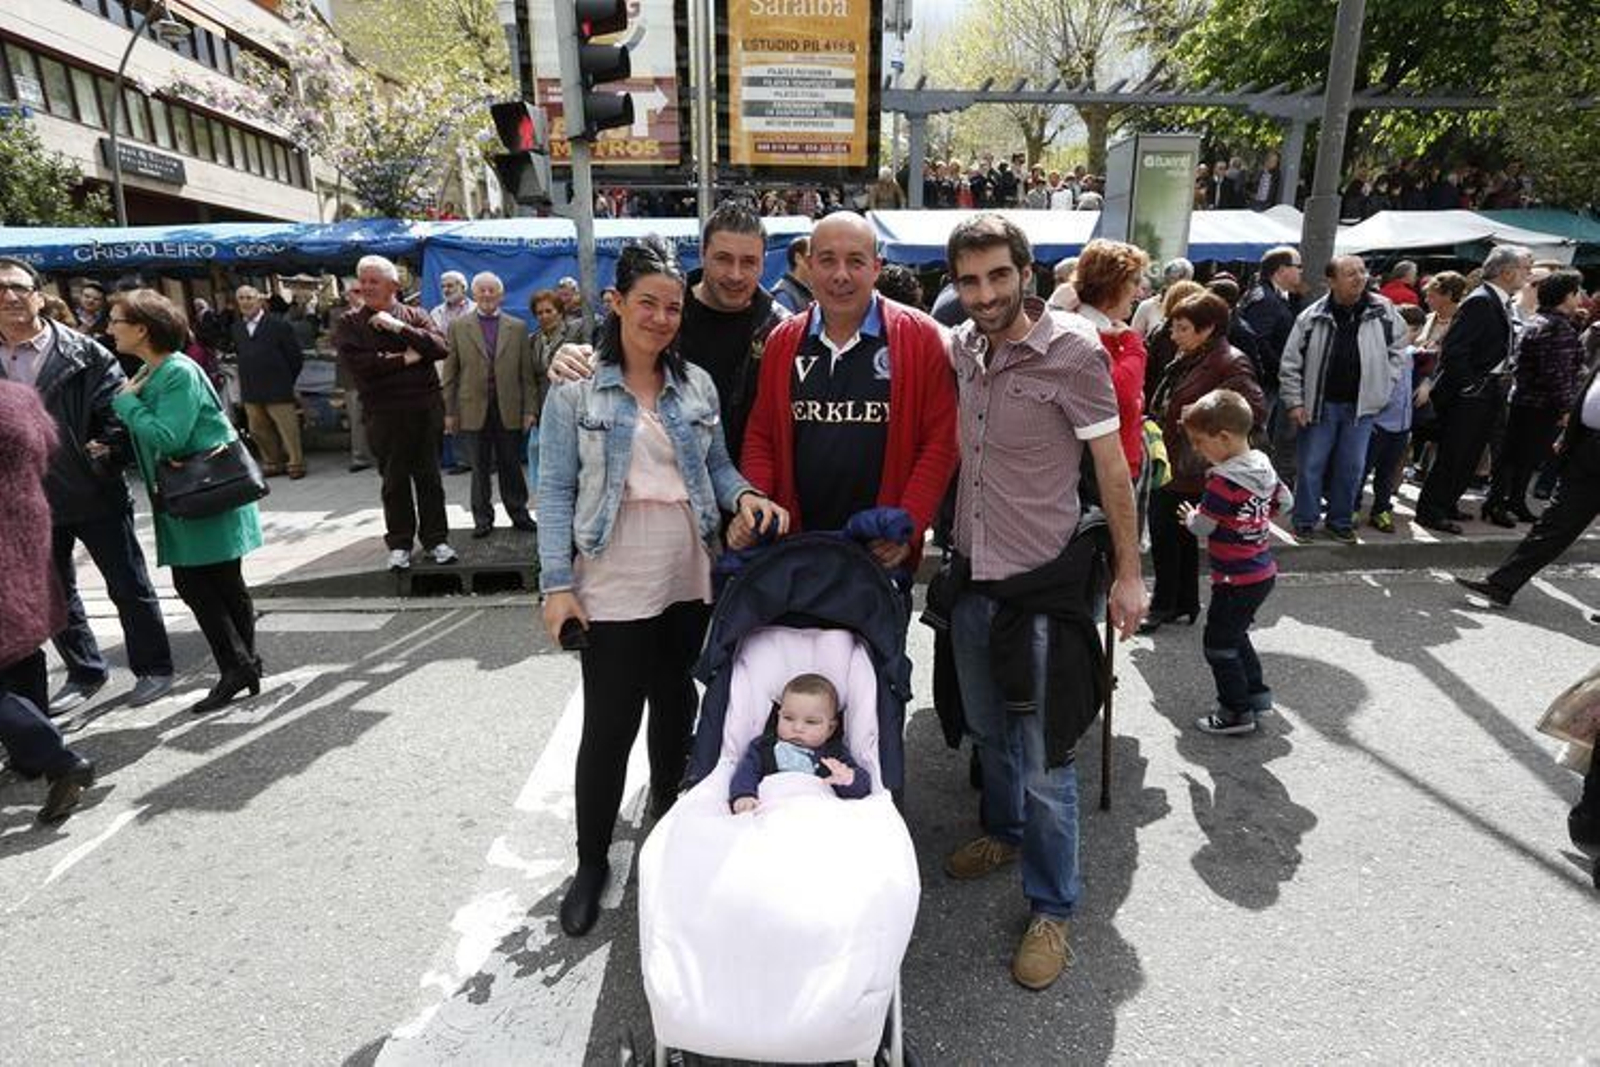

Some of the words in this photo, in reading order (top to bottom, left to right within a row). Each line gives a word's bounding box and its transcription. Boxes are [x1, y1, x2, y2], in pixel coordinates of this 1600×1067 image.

[741, 38, 799, 52] ESTUDIO
[550, 140, 660, 157] MTROS
[73, 241, 216, 262] CRISTALEIRO
[795, 355, 819, 382] V
